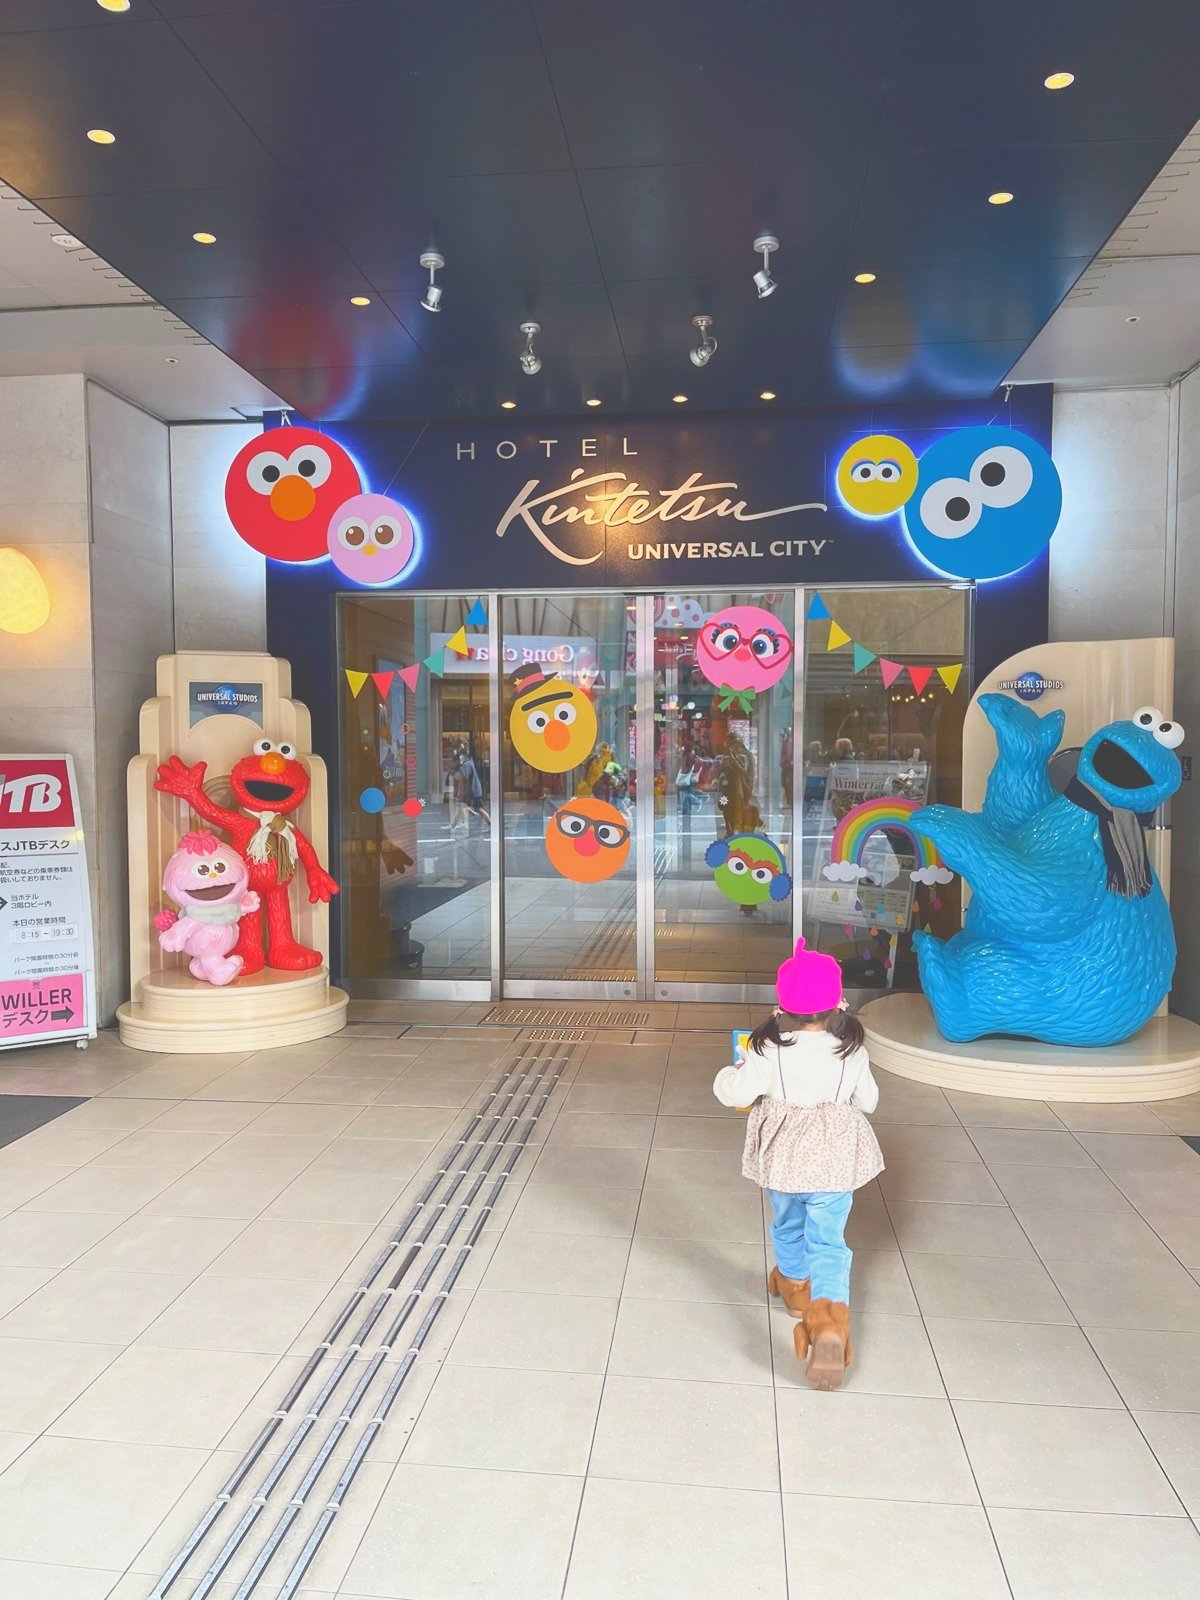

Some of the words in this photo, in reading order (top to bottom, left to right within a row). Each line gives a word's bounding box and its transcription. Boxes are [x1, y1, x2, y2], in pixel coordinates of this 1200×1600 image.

[456, 437, 638, 460] HOTEL
[495, 468, 828, 566] Kintetsu
[627, 542, 764, 561] UNIVERSAL
[998, 680, 1034, 690] UNIVERSAL
[1035, 680, 1064, 689] STUDIOS
[197, 693, 231, 702] UNIVERSAL
[232, 693, 258, 703] STUDIOS
[0, 773, 62, 813] TB
[1, 839, 70, 852] スJTBデスク
[11, 894, 40, 902] 当ホテル
[12, 916, 66, 927] 本日の営業時間
[1, 988, 72, 1011] WILLER
[2, 1009, 49, 1029] デスク
